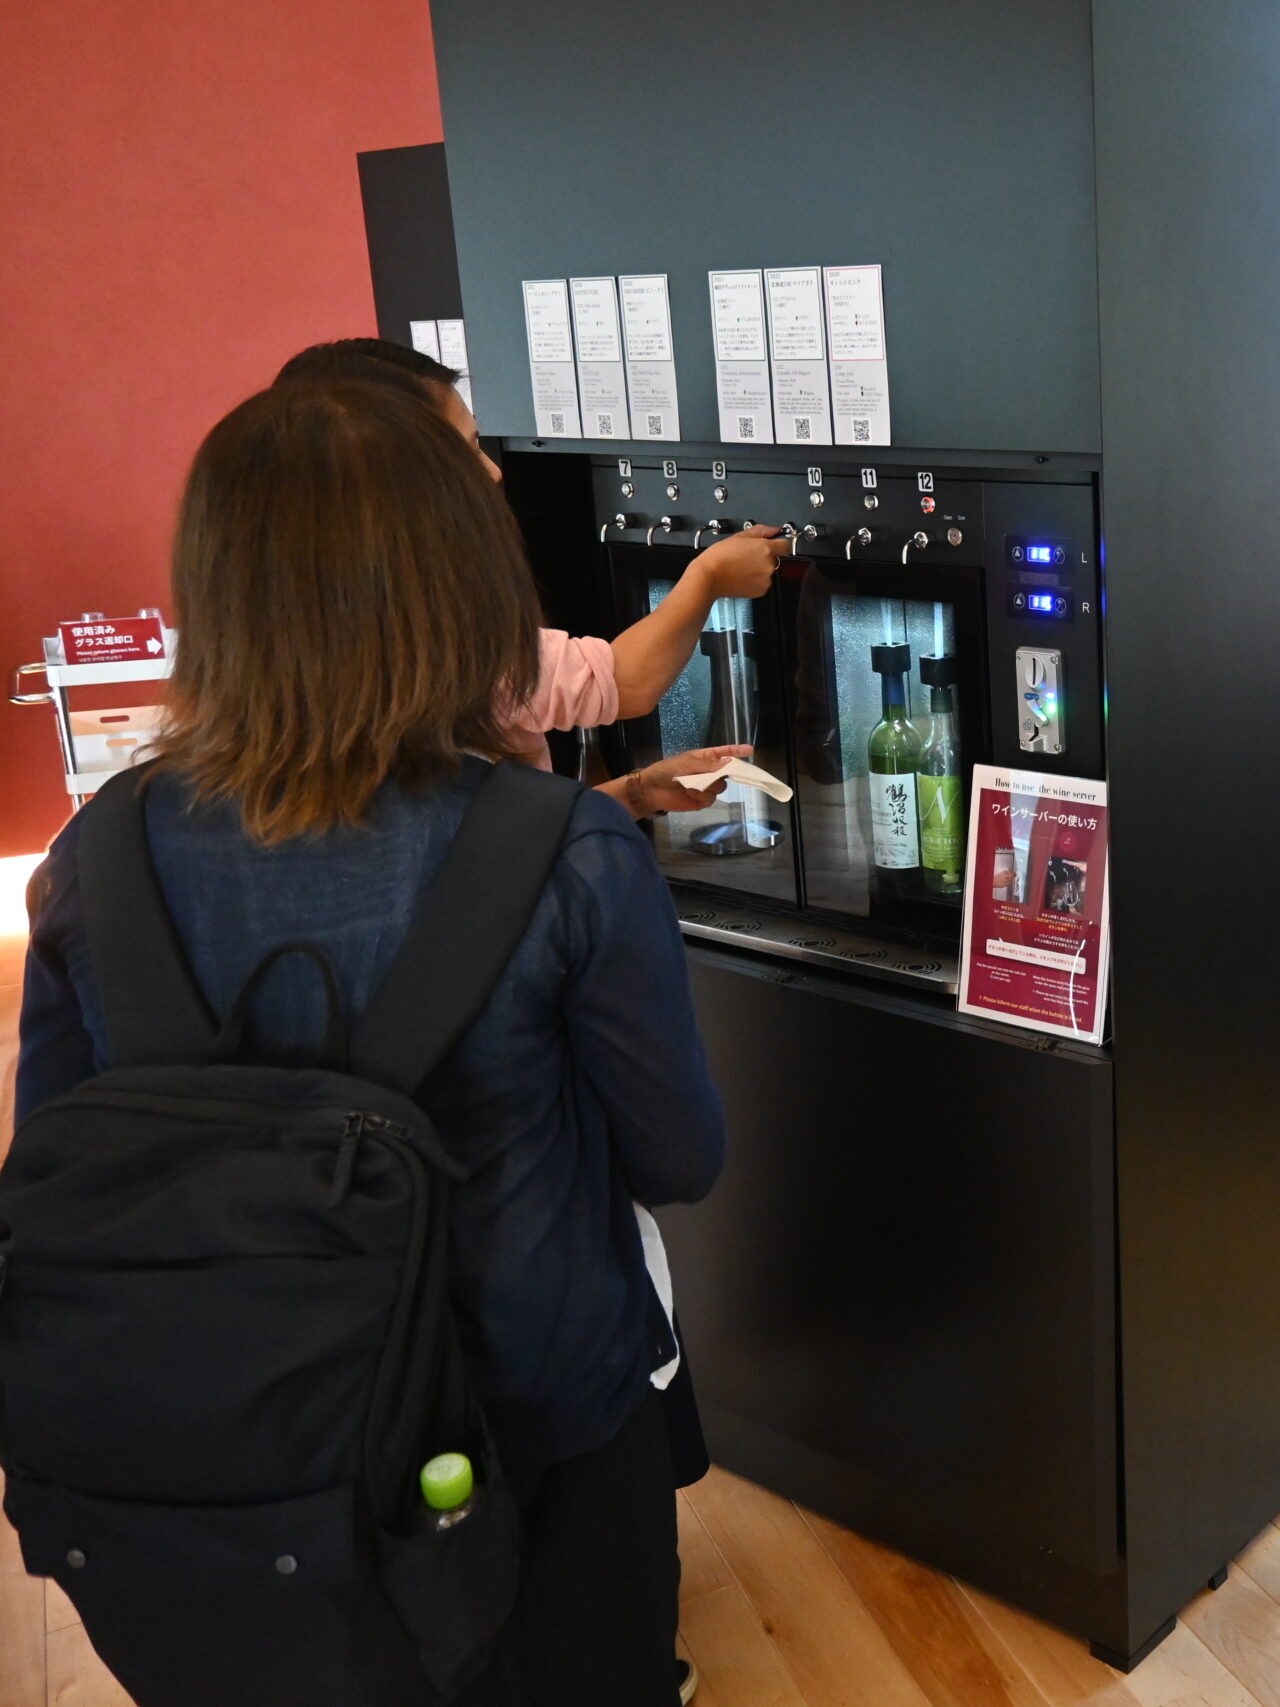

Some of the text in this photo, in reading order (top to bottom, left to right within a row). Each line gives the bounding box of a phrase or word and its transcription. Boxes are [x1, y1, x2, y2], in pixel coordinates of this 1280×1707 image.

[621, 461, 629, 475] 7
[666, 463, 674, 476] 8
[715, 463, 723, 476] 9
[809, 470, 820, 484] 10
[863, 472, 876, 485] 11
[920, 474, 932, 489] 12
[1081, 552, 1087, 563] L
[1083, 602, 1090, 613] R
[72, 626, 115, 636] 使用済み
[75, 635, 133, 647] グラス返却口
[995, 778, 1009, 787] How
[1039, 785, 1050, 794] the
[1053, 787, 1070, 797] wine
[1073, 792, 1096, 801] server
[992, 804, 1098, 830] ワインサーバーの使い方
